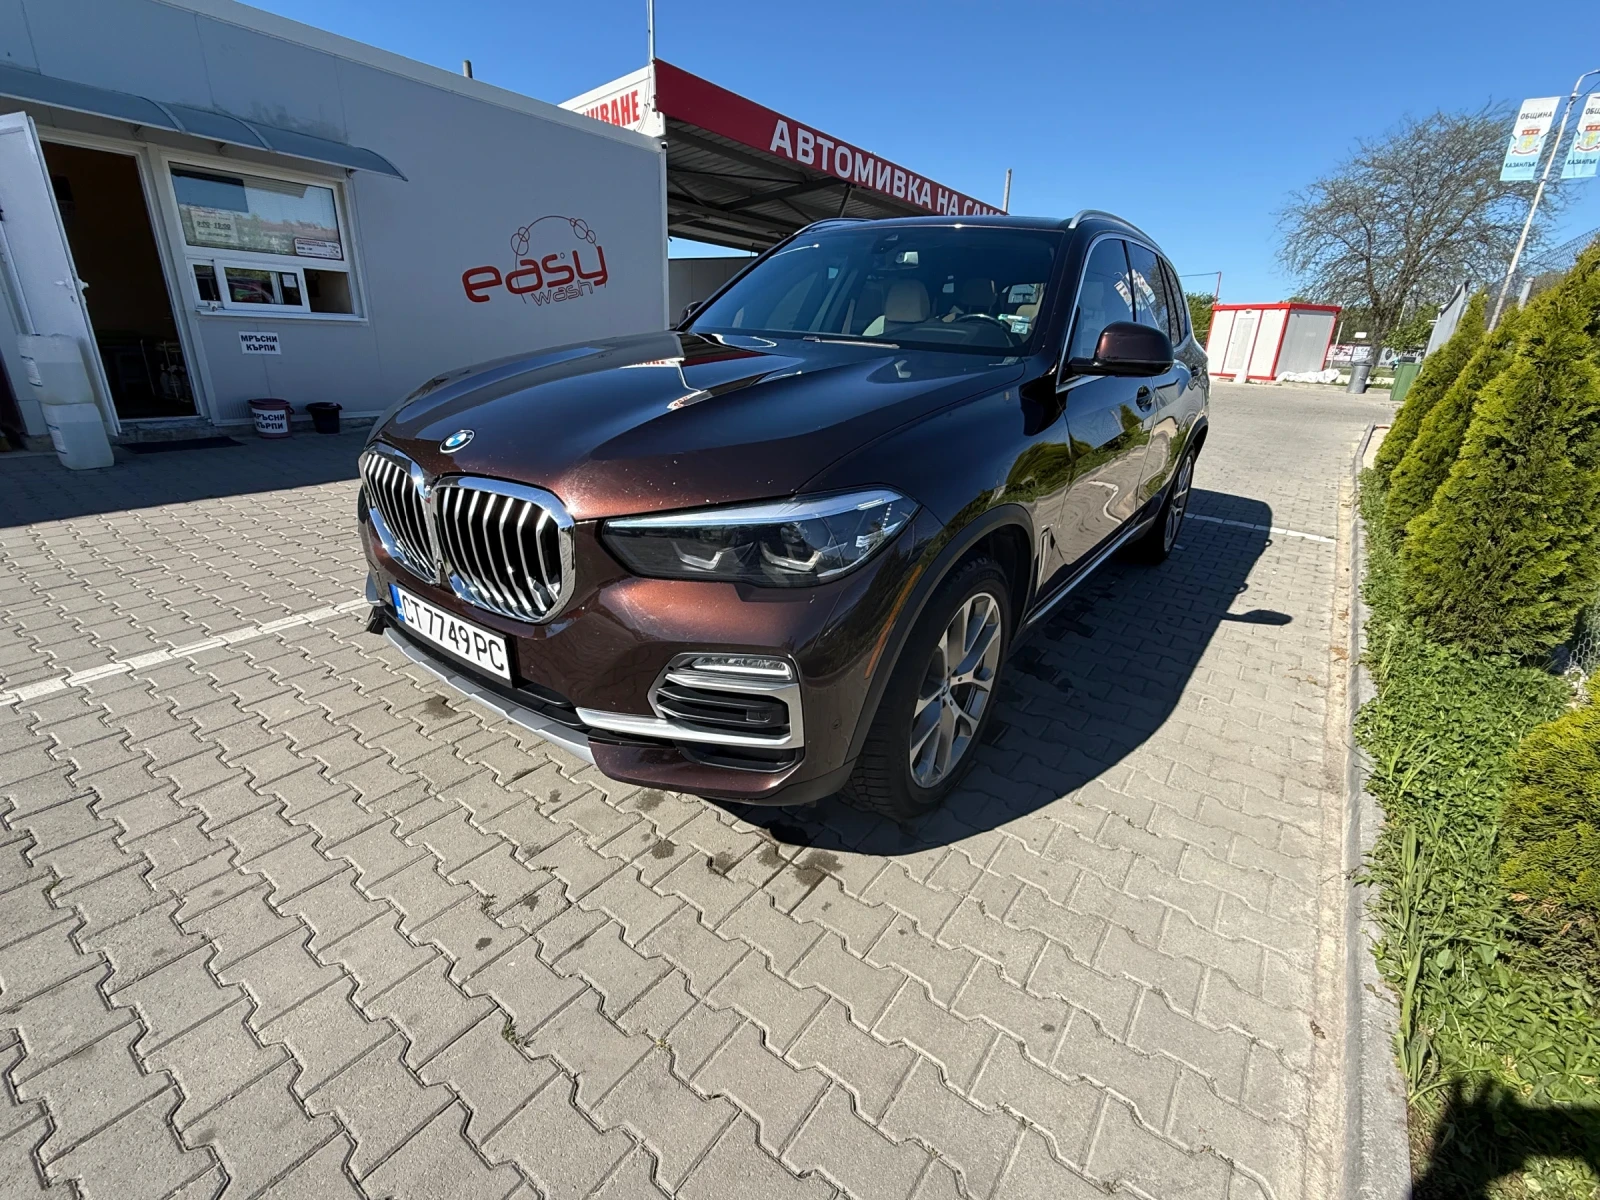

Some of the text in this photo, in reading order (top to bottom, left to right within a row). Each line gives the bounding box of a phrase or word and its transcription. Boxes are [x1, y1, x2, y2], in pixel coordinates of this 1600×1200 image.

[1520, 111, 1552, 120] ОБЩИНА
[769, 119, 933, 211] АВТОМИВКА
[936, 187, 960, 216] НА
[462, 245, 608, 303] easy
[531, 280, 593, 306] wash
[240, 334, 278, 343] МРЪСНИ
[246, 343, 276, 352] КЪРПИ
